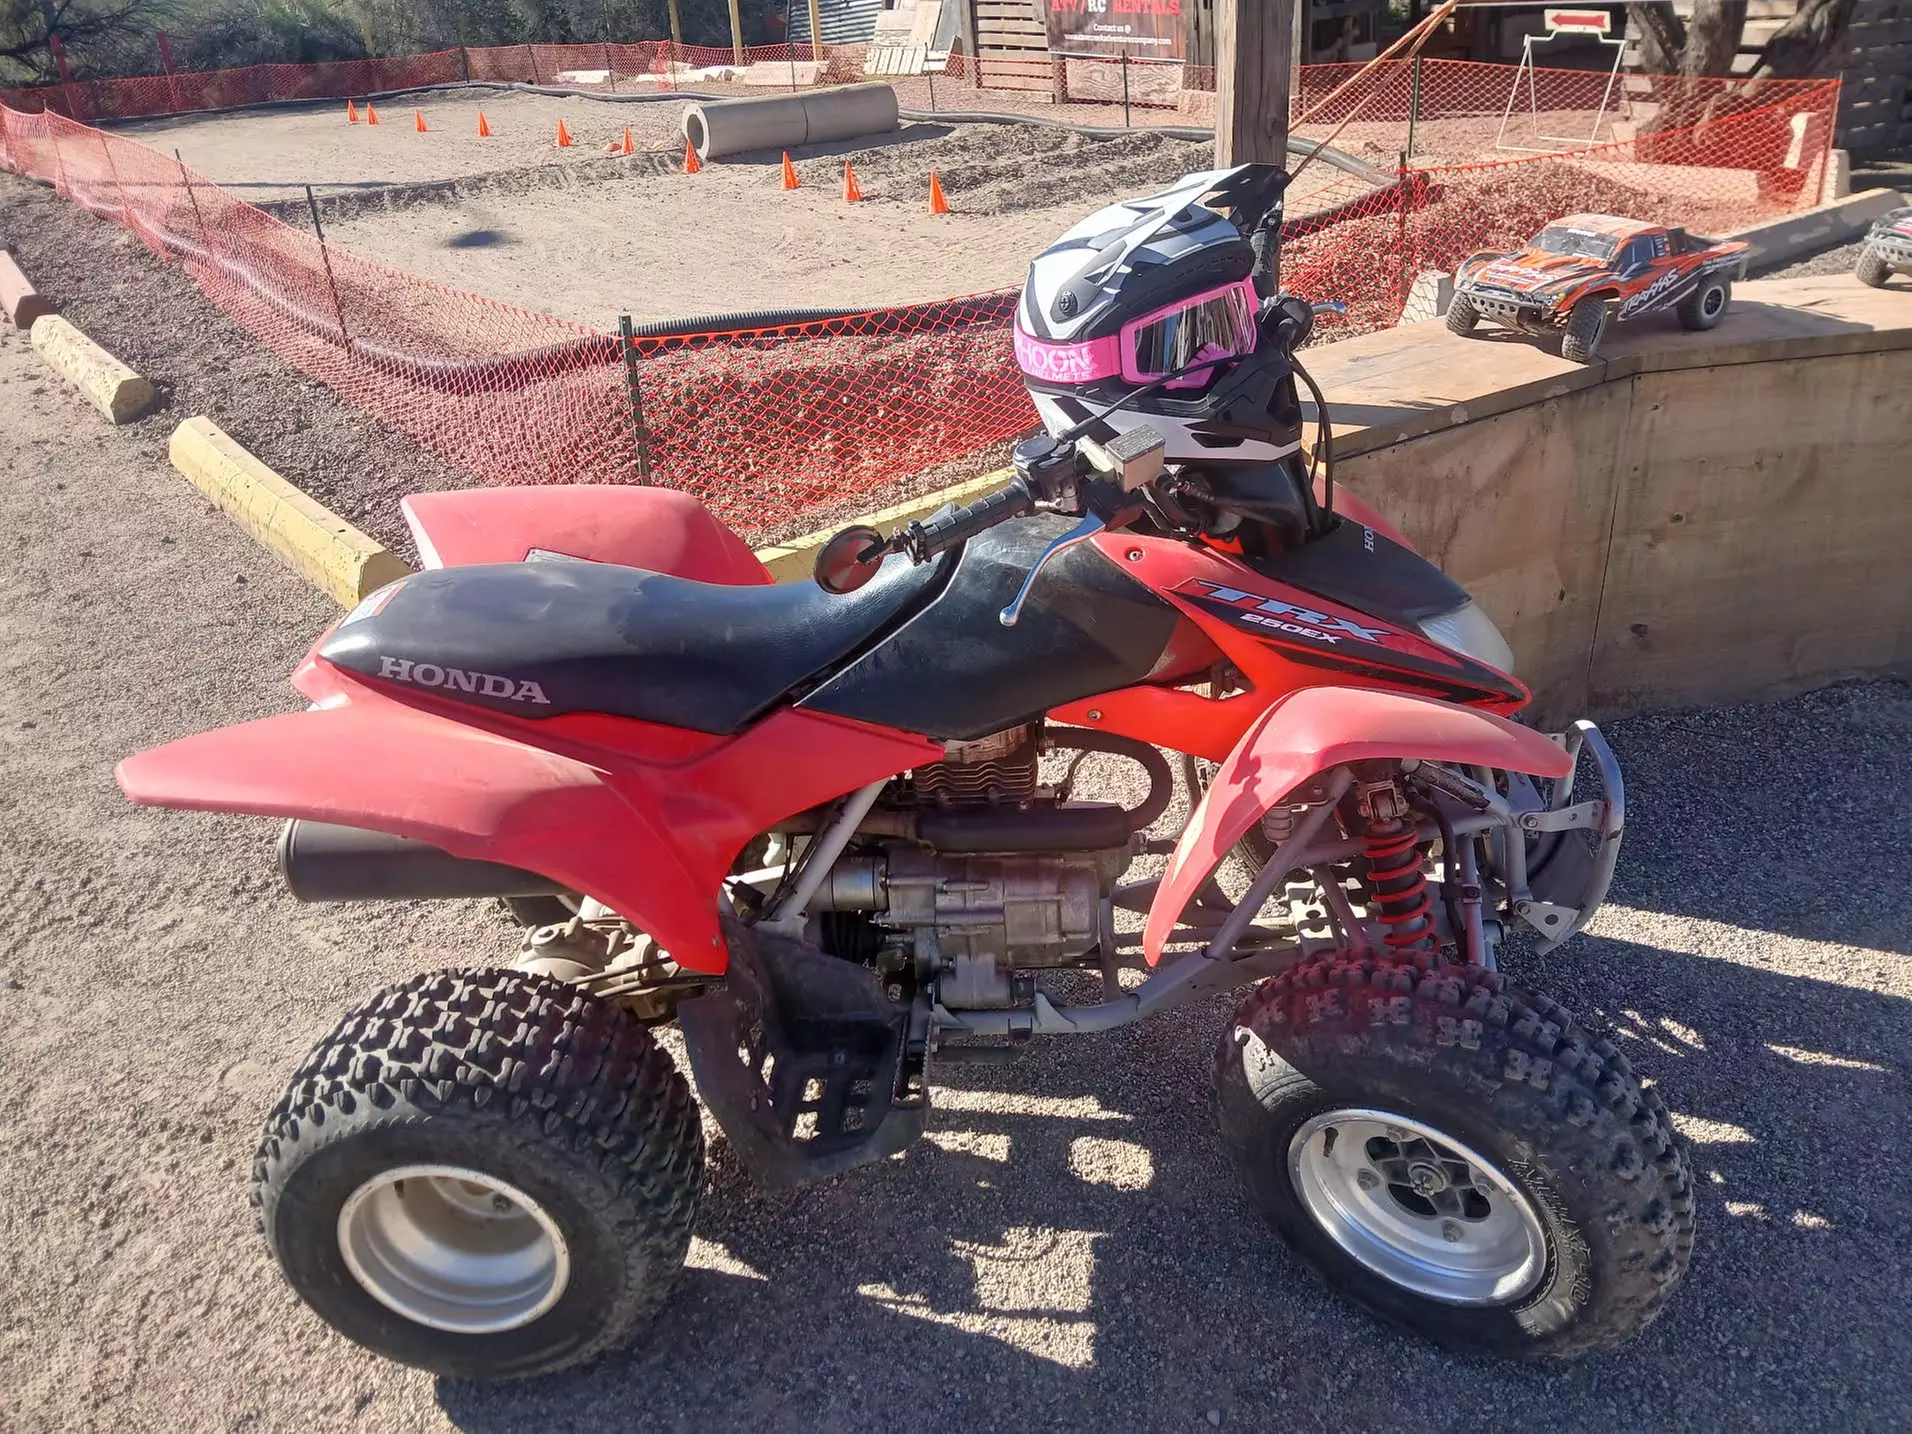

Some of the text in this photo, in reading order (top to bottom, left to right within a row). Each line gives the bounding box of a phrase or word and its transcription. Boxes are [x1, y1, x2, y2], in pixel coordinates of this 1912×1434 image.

[1093, 23, 1116, 32] Contact
[1031, 366, 1092, 380] HELMETS
[1364, 527, 1375, 553] HO
[1197, 580, 1392, 643] TRX
[1240, 613, 1342, 644] 250EX
[377, 655, 551, 704] HONDA
